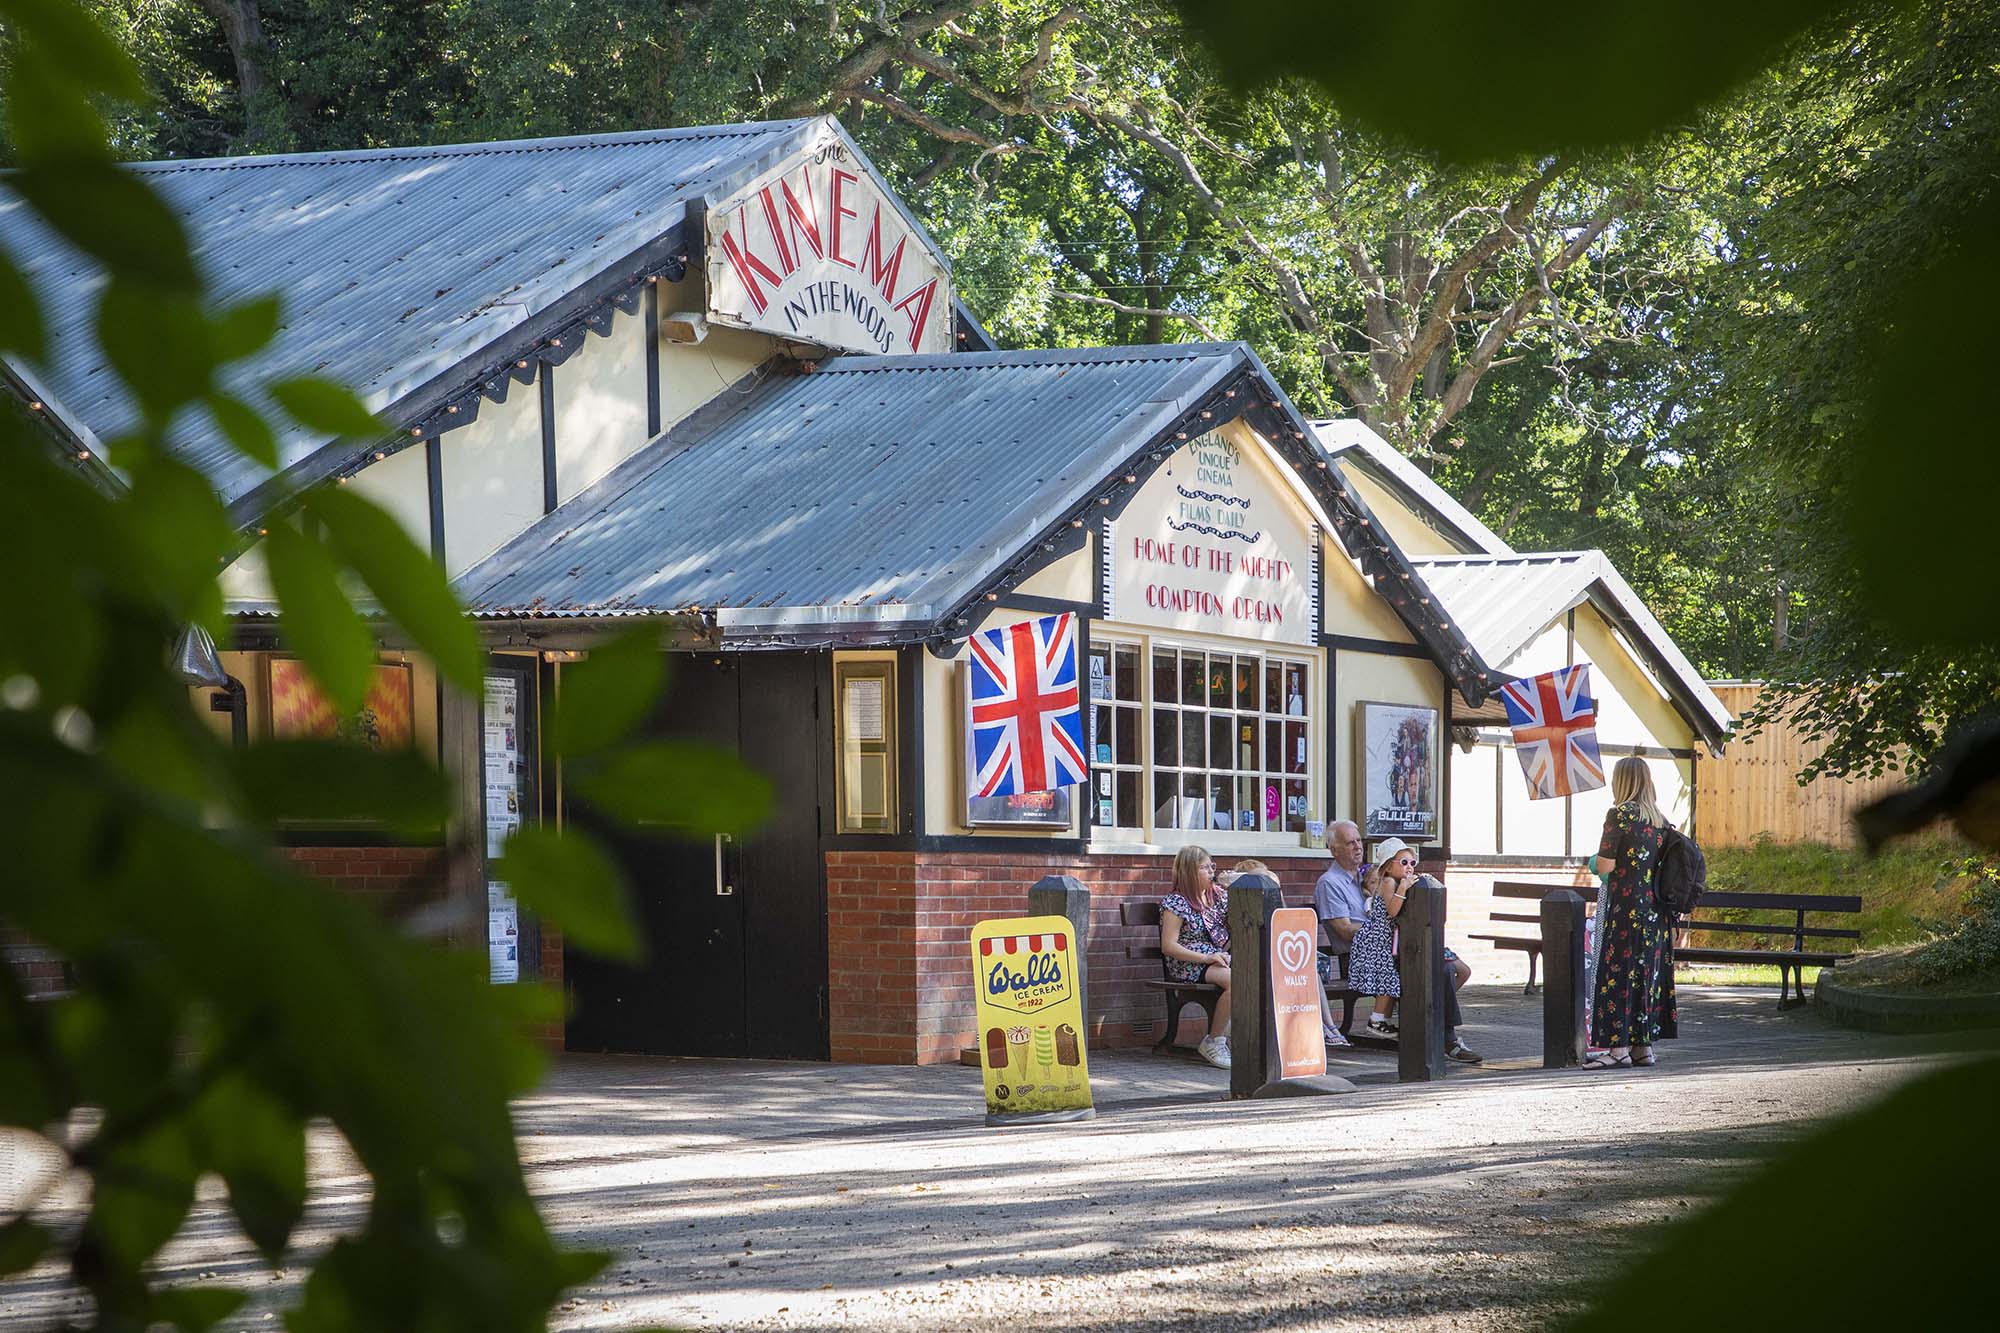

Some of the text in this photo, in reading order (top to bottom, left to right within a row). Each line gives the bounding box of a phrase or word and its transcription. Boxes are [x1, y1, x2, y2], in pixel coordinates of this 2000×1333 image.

[720, 165, 938, 354] KINEMA
[784, 280, 895, 354] IN THE WOODS
[1197, 467, 1232, 487] CINEMA
[1179, 501, 1247, 529] FILMS DAILY
[1134, 537, 1293, 582] HOME OF THE MIGHTY
[1145, 583, 1283, 625] COMPTON ORGAN
[1378, 811, 1417, 822] BULLET
[989, 953, 1061, 995] Wall's
[1284, 975, 1308, 987] WALL'S
[1014, 983, 1065, 1001] ICE CREAM
[1027, 998, 1043, 1007] 1922
